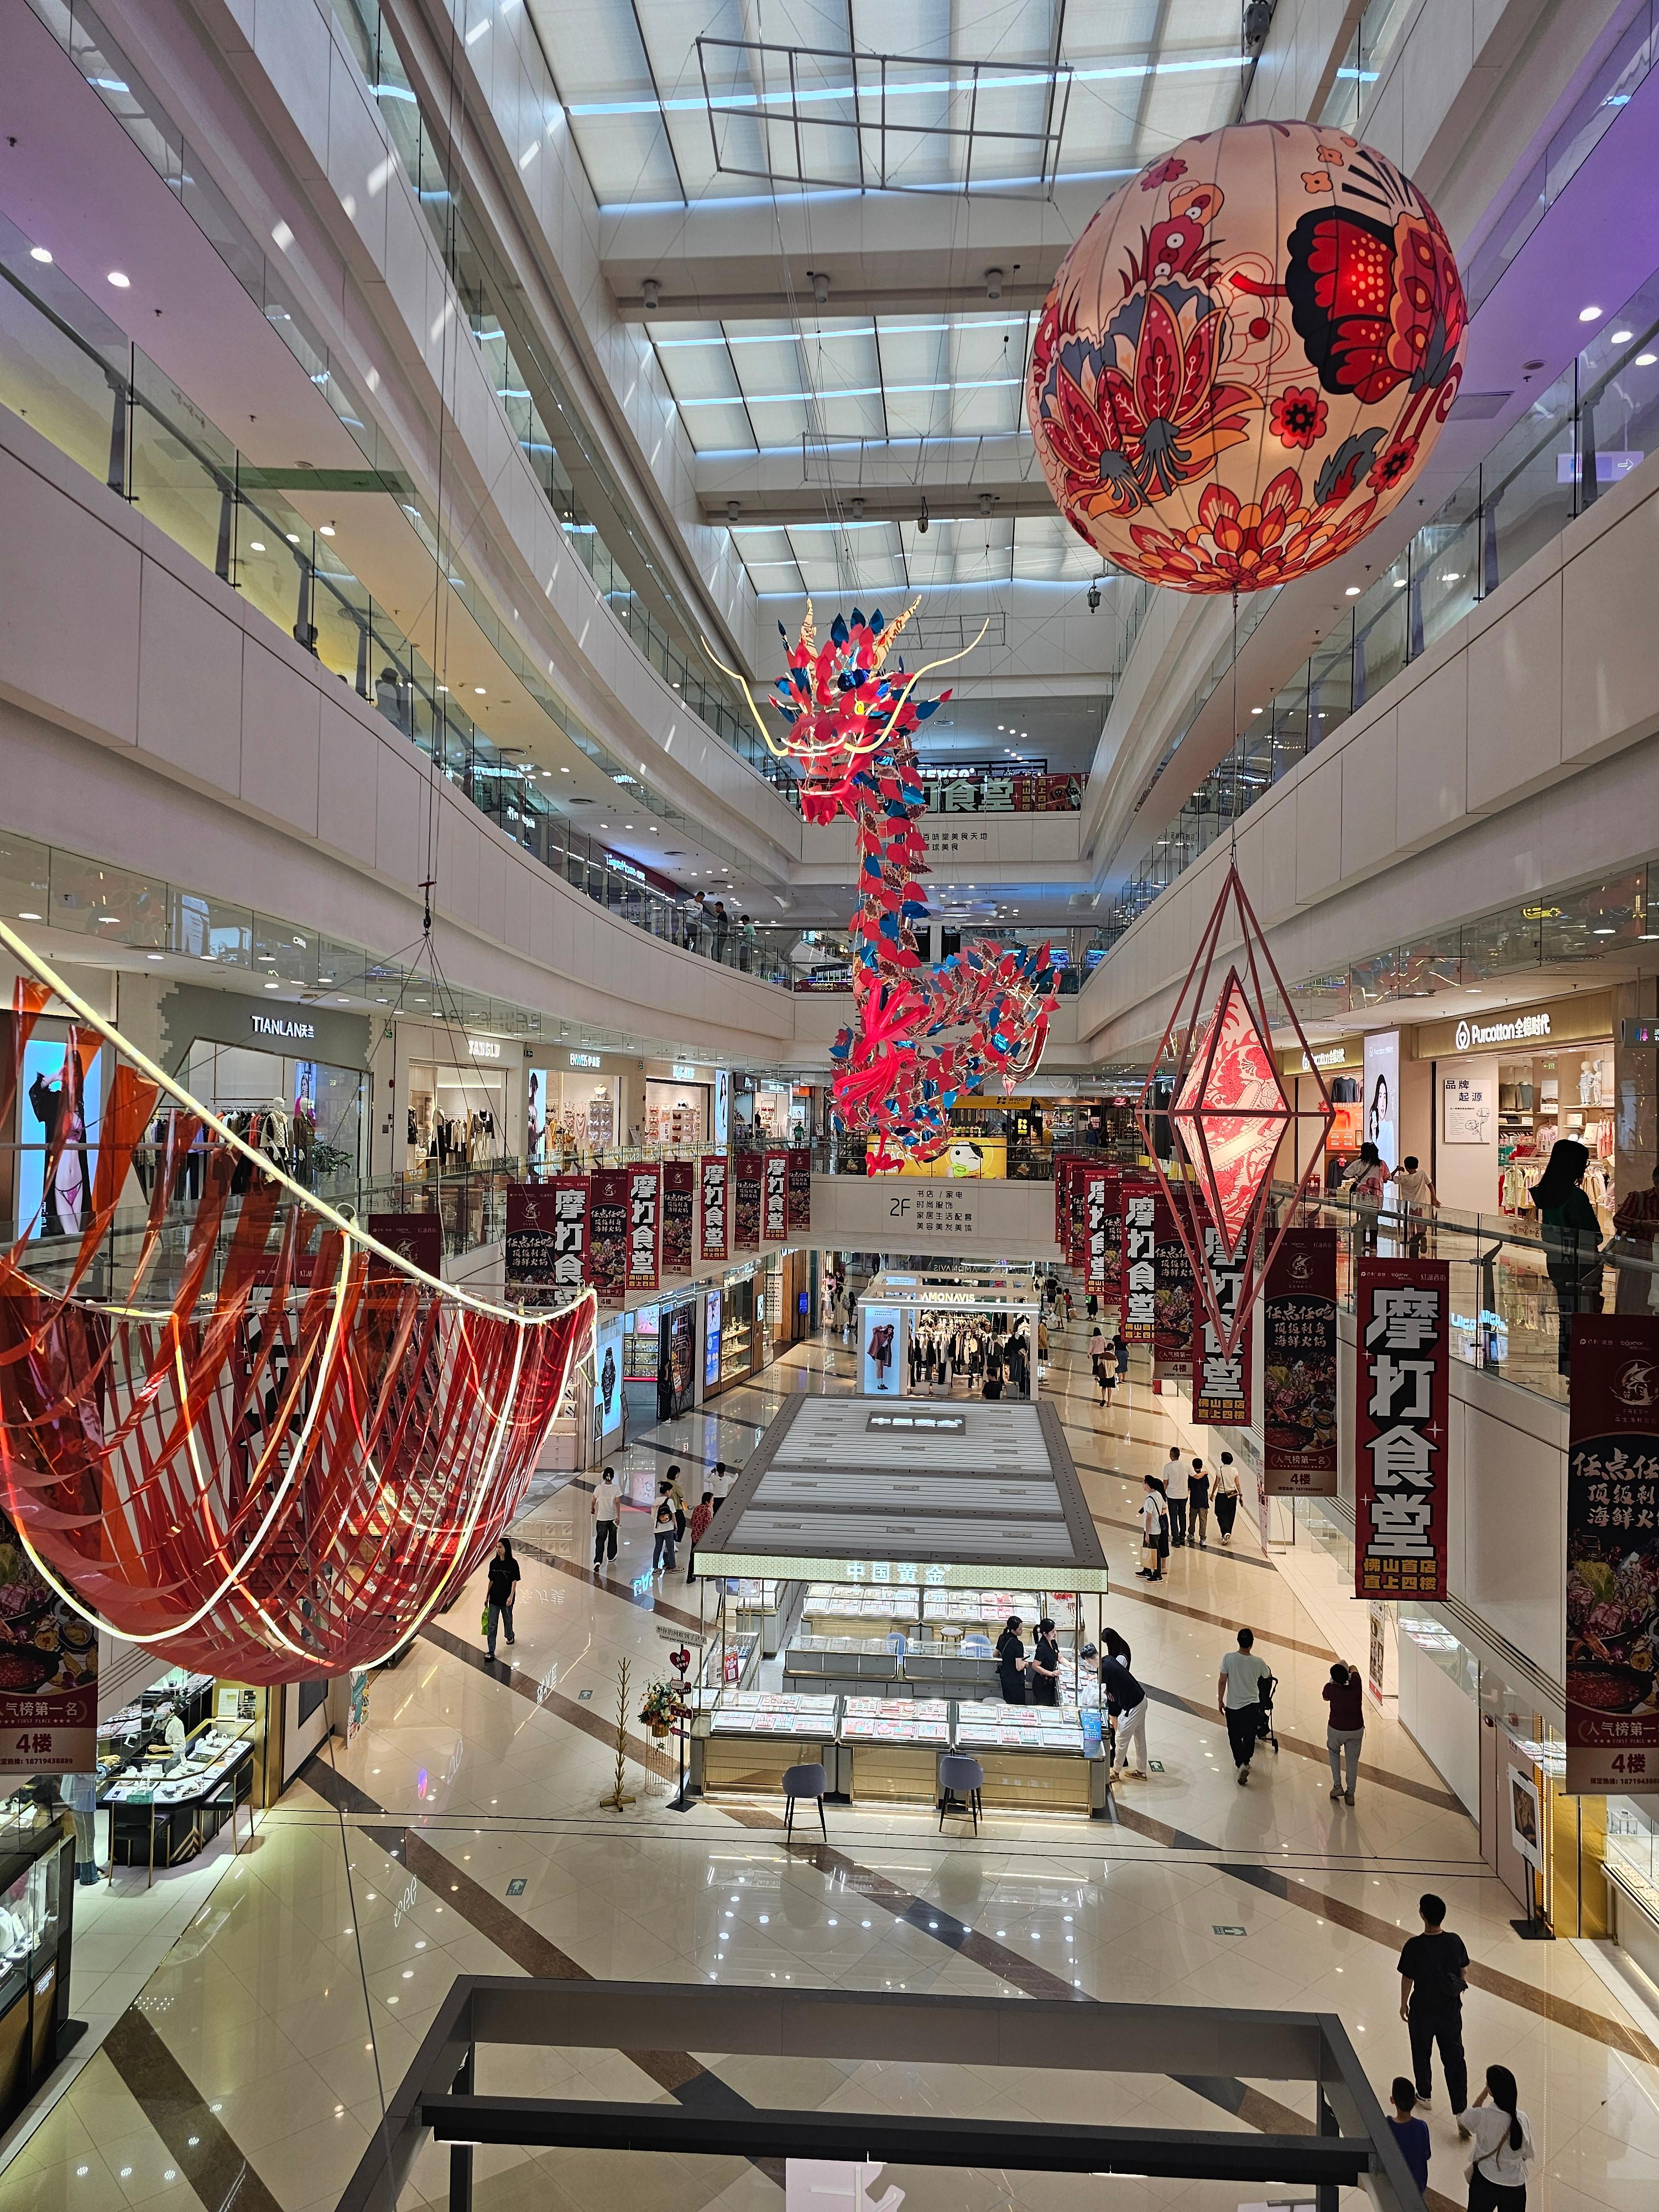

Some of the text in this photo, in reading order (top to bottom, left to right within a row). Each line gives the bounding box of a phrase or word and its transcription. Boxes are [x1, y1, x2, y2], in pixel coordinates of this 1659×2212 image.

[923, 832, 988, 841] 百味堂美食天地
[1446, 1079, 1469, 1089] 品牌
[1458, 1092, 1483, 1102] 起源
[767, 1159, 786, 1229] 摩打食堂
[703, 1164, 725, 1247] 摩打食堂
[890, 1198, 910, 1217] 2F
[916, 1201, 953, 1210] 时尚服饰
[590, 1209, 626, 1218] 任点任吃
[916, 1212, 972, 1221] 家居生活配套
[630, 1175, 657, 1275] 摩打食堂
[916, 1222, 972, 1232] 美容美发美体
[507, 1234, 554, 1249] 任点任吃
[1125, 1197, 1154, 1323] 摩打食堂
[921, 1292, 975, 1302] AMONAVIS
[1266, 1302, 1335, 1321] 任点任吃
[1275, 1322, 1326, 1334] 顶级刺身
[1274, 1334, 1327, 1348] 海鲜火锅
[1172, 1364, 1187, 1373] 4楼
[1198, 1399, 1245, 1409] 佛山首店
[1198, 1409, 1245, 1420] 直上四楼
[1366, 1287, 1439, 1557] 摩打食堂
[1276, 1455, 1325, 1465] 人气榜第一名
[1290, 1473, 1311, 1485] 4楼
[1587, 1483, 1659, 1505] 顶级刺
[1587, 1506, 1659, 1530] 海鲜火
[847, 1561, 946, 1585] 中国黄金
[1364, 1558, 1437, 1574] 佛山首店
[1364, 1574, 1437, 1590] 直上四楼
[0, 1702, 78, 1717] 气榜第一名
[1587, 1721, 1659, 1736] 人气榜第一
[16, 1733, 52, 1753] 4楼
[1611, 1753, 1646, 1773] 4楼
